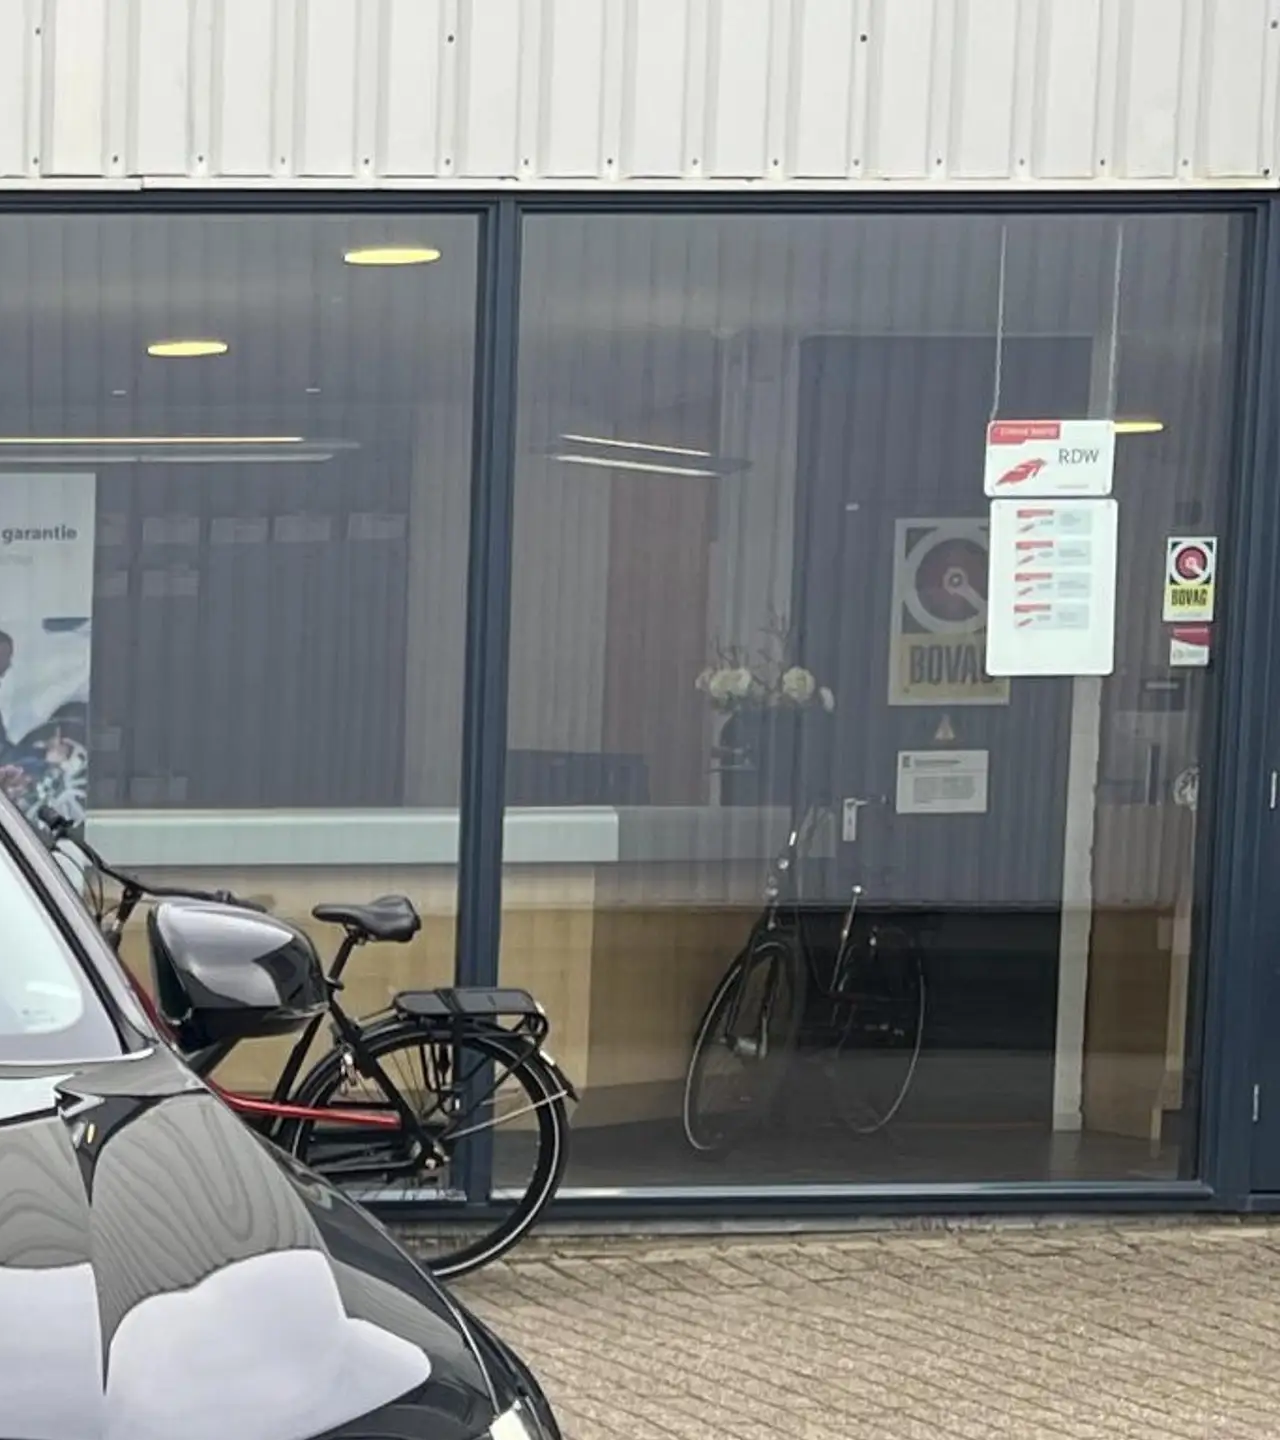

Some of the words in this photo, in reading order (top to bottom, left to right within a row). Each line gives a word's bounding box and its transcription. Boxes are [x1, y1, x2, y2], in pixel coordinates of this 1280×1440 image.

[1058, 448, 1099, 464] RDW
[2, 524, 78, 545] garantie
[1171, 588, 1208, 606] BOVAG
